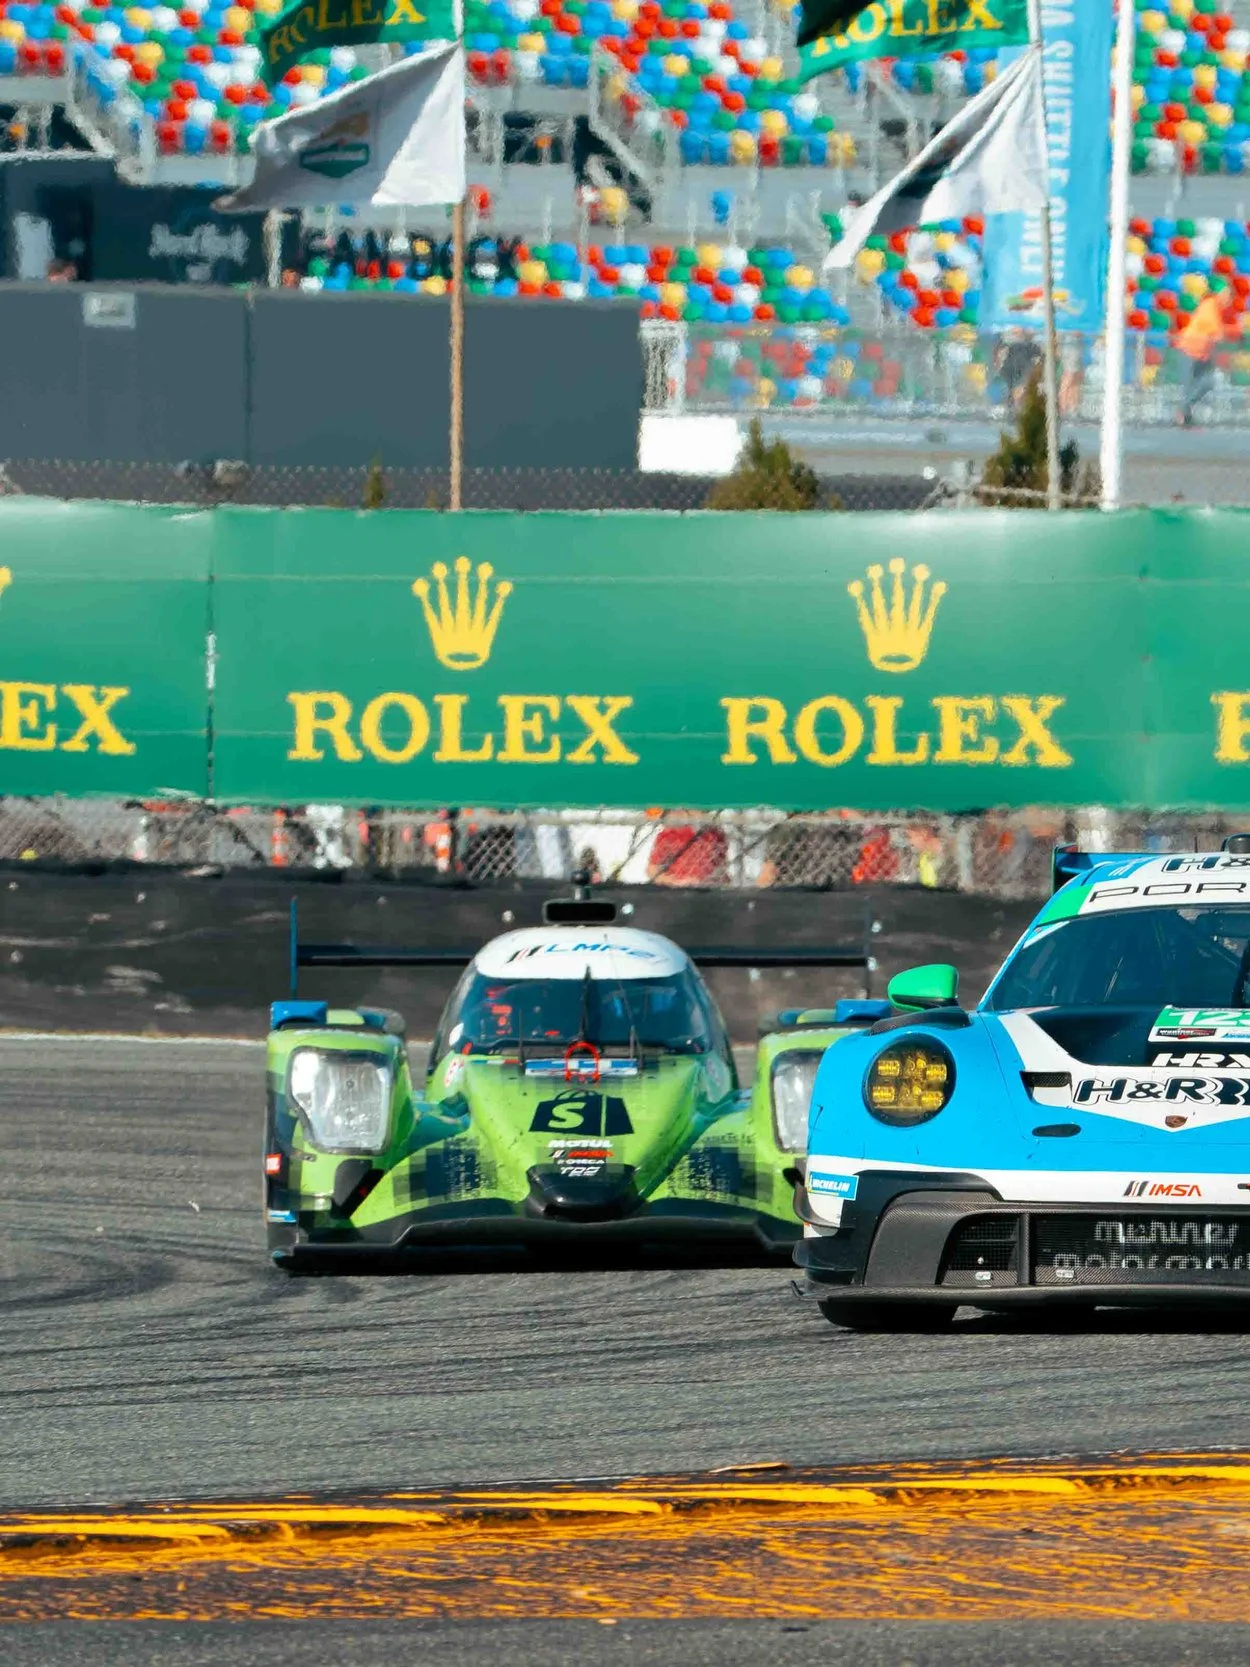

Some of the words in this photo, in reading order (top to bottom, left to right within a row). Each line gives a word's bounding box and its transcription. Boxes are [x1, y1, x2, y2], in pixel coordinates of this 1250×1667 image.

[288, 692, 639, 764] ROLEX
[721, 695, 1072, 768] ROLEX
[1149, 1184, 1202, 1197] IMSA
